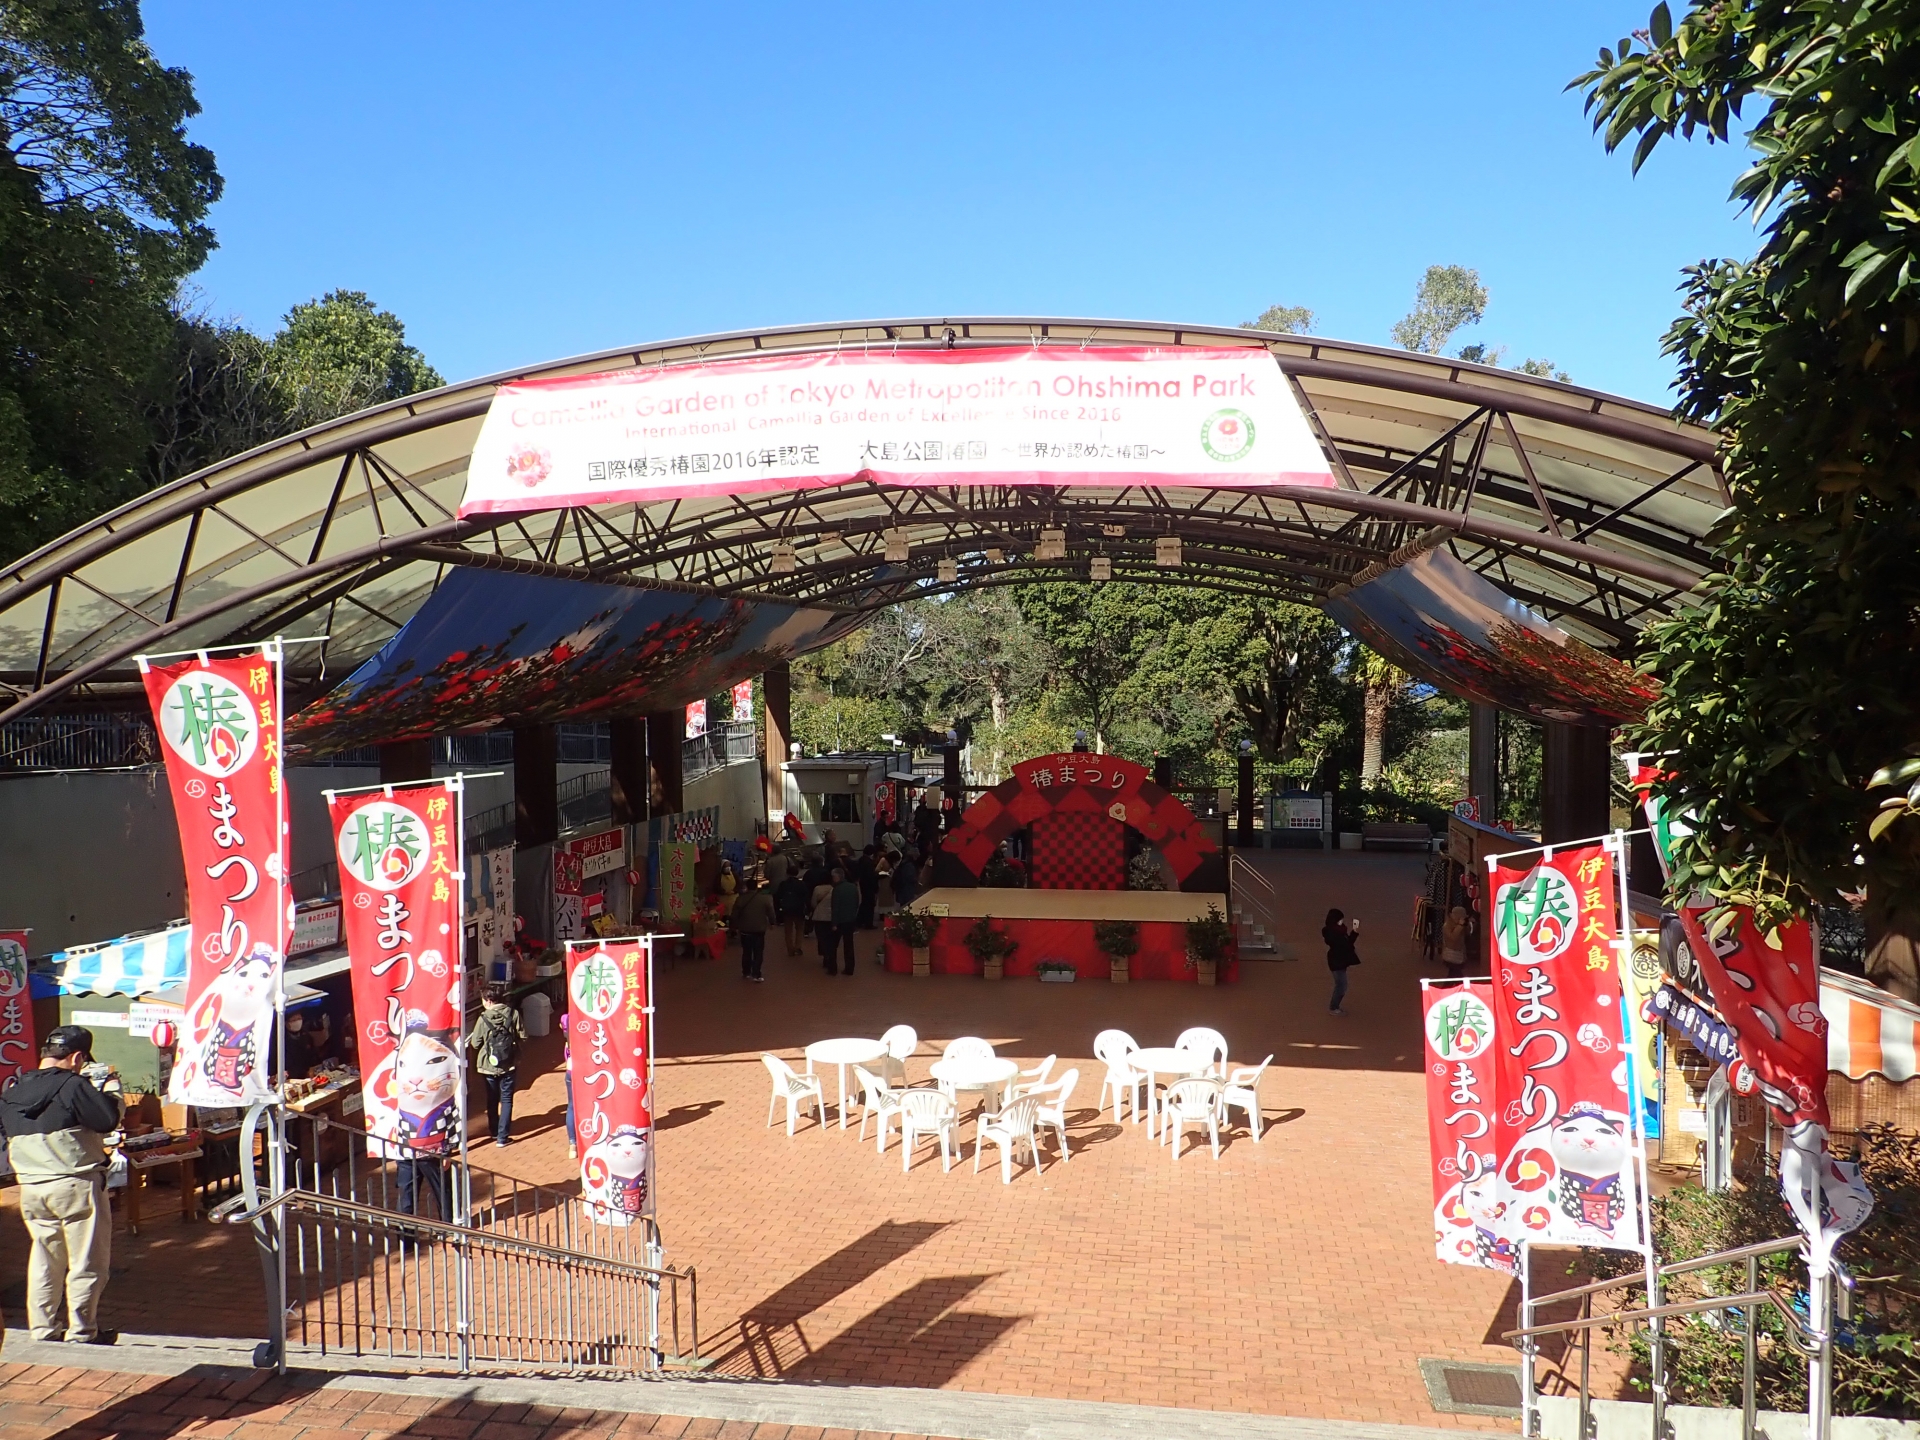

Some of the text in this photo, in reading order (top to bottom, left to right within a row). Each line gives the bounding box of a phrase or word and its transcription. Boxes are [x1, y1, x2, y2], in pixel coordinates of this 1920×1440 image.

[511, 373, 1256, 428] Camellia Garden of Tokyo Metropolitan Ohshima Park
[625, 405, 1122, 439] International Camellia Garden of Excellene Since 2016
[588, 444, 820, 481] 国際優秀椿園2016年認定
[860, 440, 988, 462] 大島公園椿園
[248, 666, 281, 796] 伊豆大島
[1029, 765, 1126, 789] 椿まつり
[1056, 754, 1101, 765] 伊豆大島
[426, 797, 451, 903] 伊豆大島
[582, 834, 612, 857] 伊豆大島
[1576, 857, 1610, 973] 伊豆大島
[622, 952, 643, 1033] 伊豆大島
